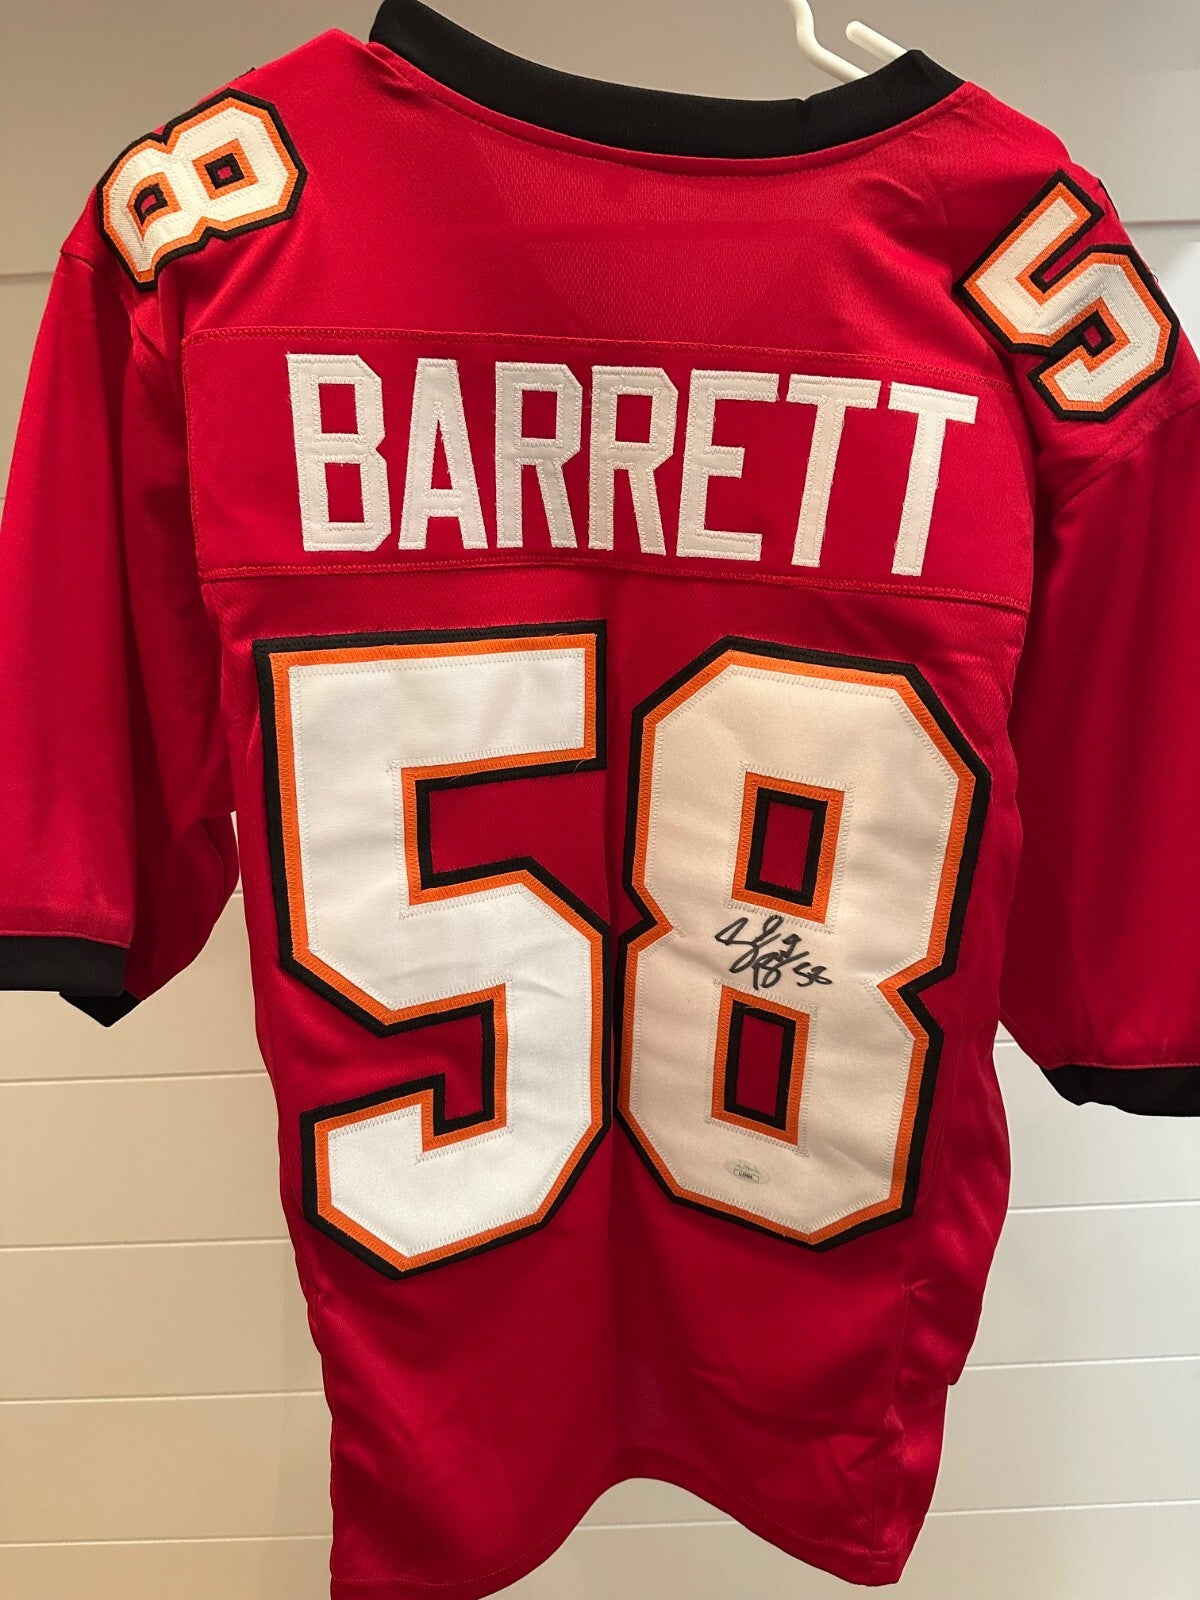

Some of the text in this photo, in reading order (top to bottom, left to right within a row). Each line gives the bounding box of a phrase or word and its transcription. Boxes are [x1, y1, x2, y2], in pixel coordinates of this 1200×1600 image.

[97, 88, 308, 291] 8
[952, 169, 1180, 421] 5
[286, 352, 978, 578] BARRETT
[252, 619, 993, 1280] 58
